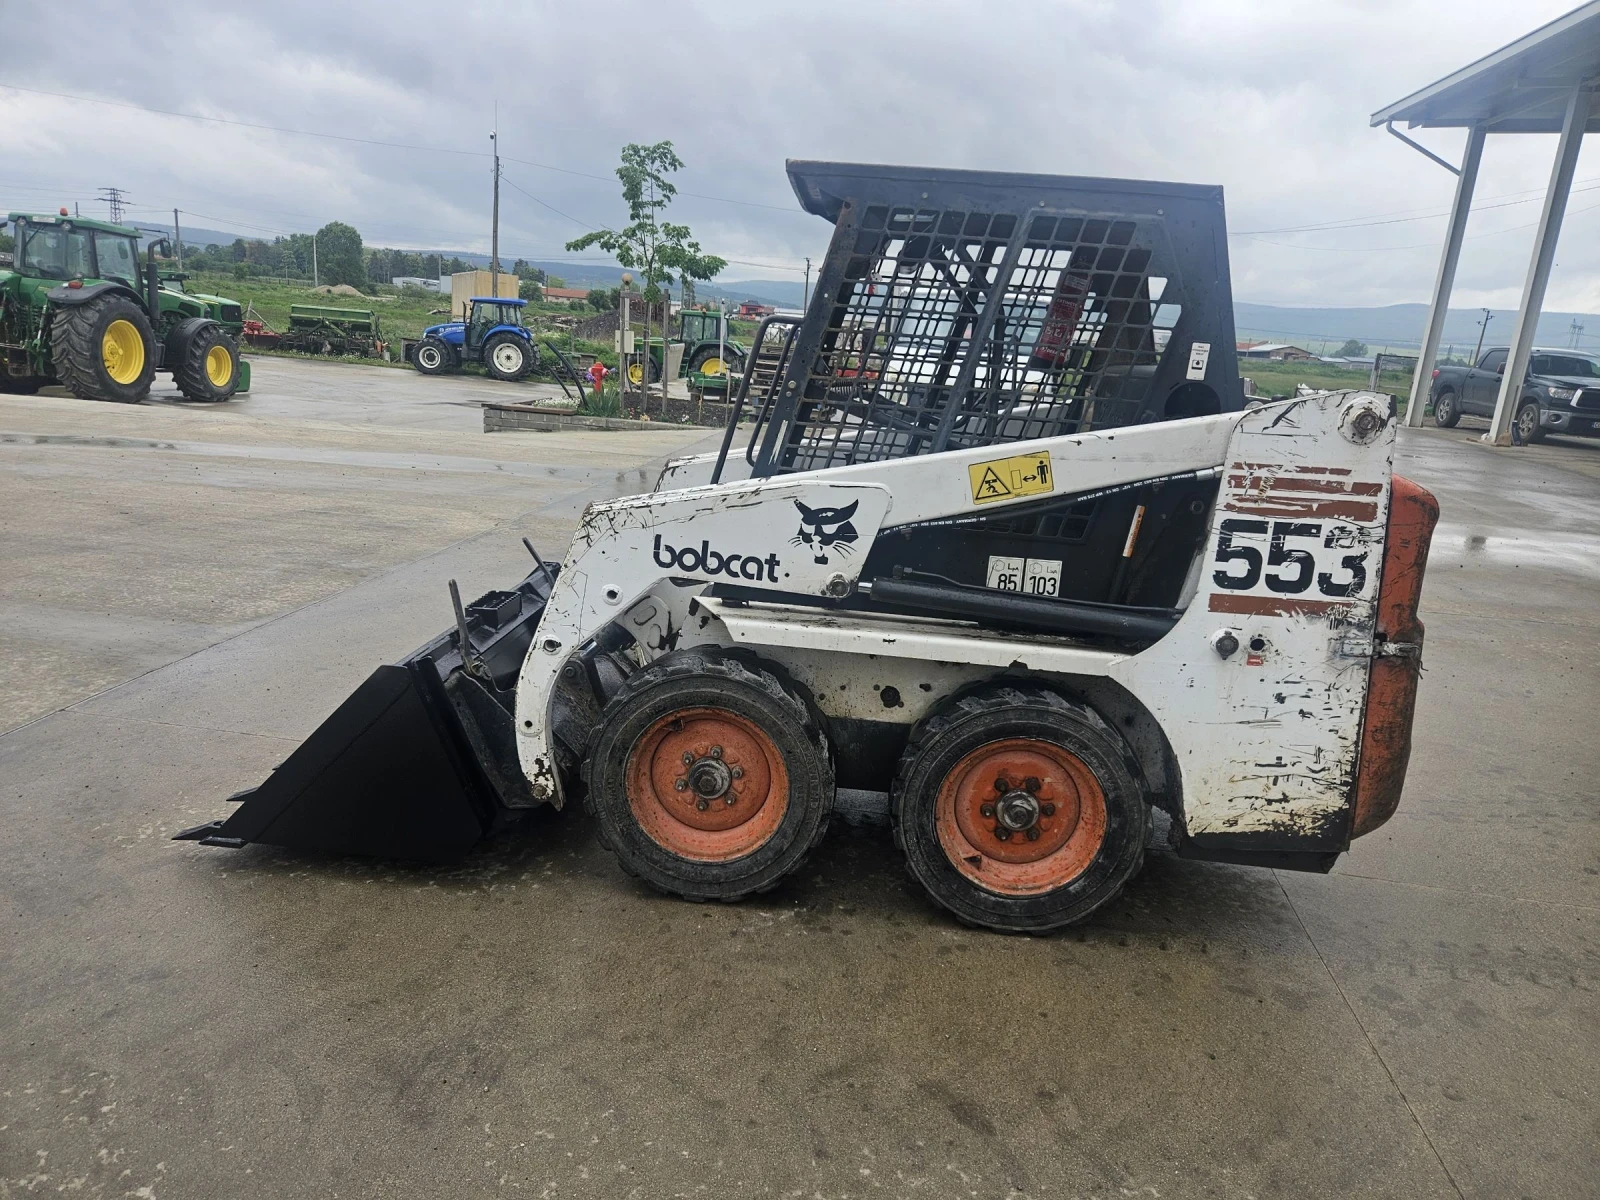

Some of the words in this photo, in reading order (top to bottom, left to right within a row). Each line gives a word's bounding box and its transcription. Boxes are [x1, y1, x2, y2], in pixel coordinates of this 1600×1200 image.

[653, 534, 780, 583] bobcat
[1213, 518, 1368, 598] 553
[998, 573, 1018, 591] 85
[1029, 576, 1057, 595] 103
